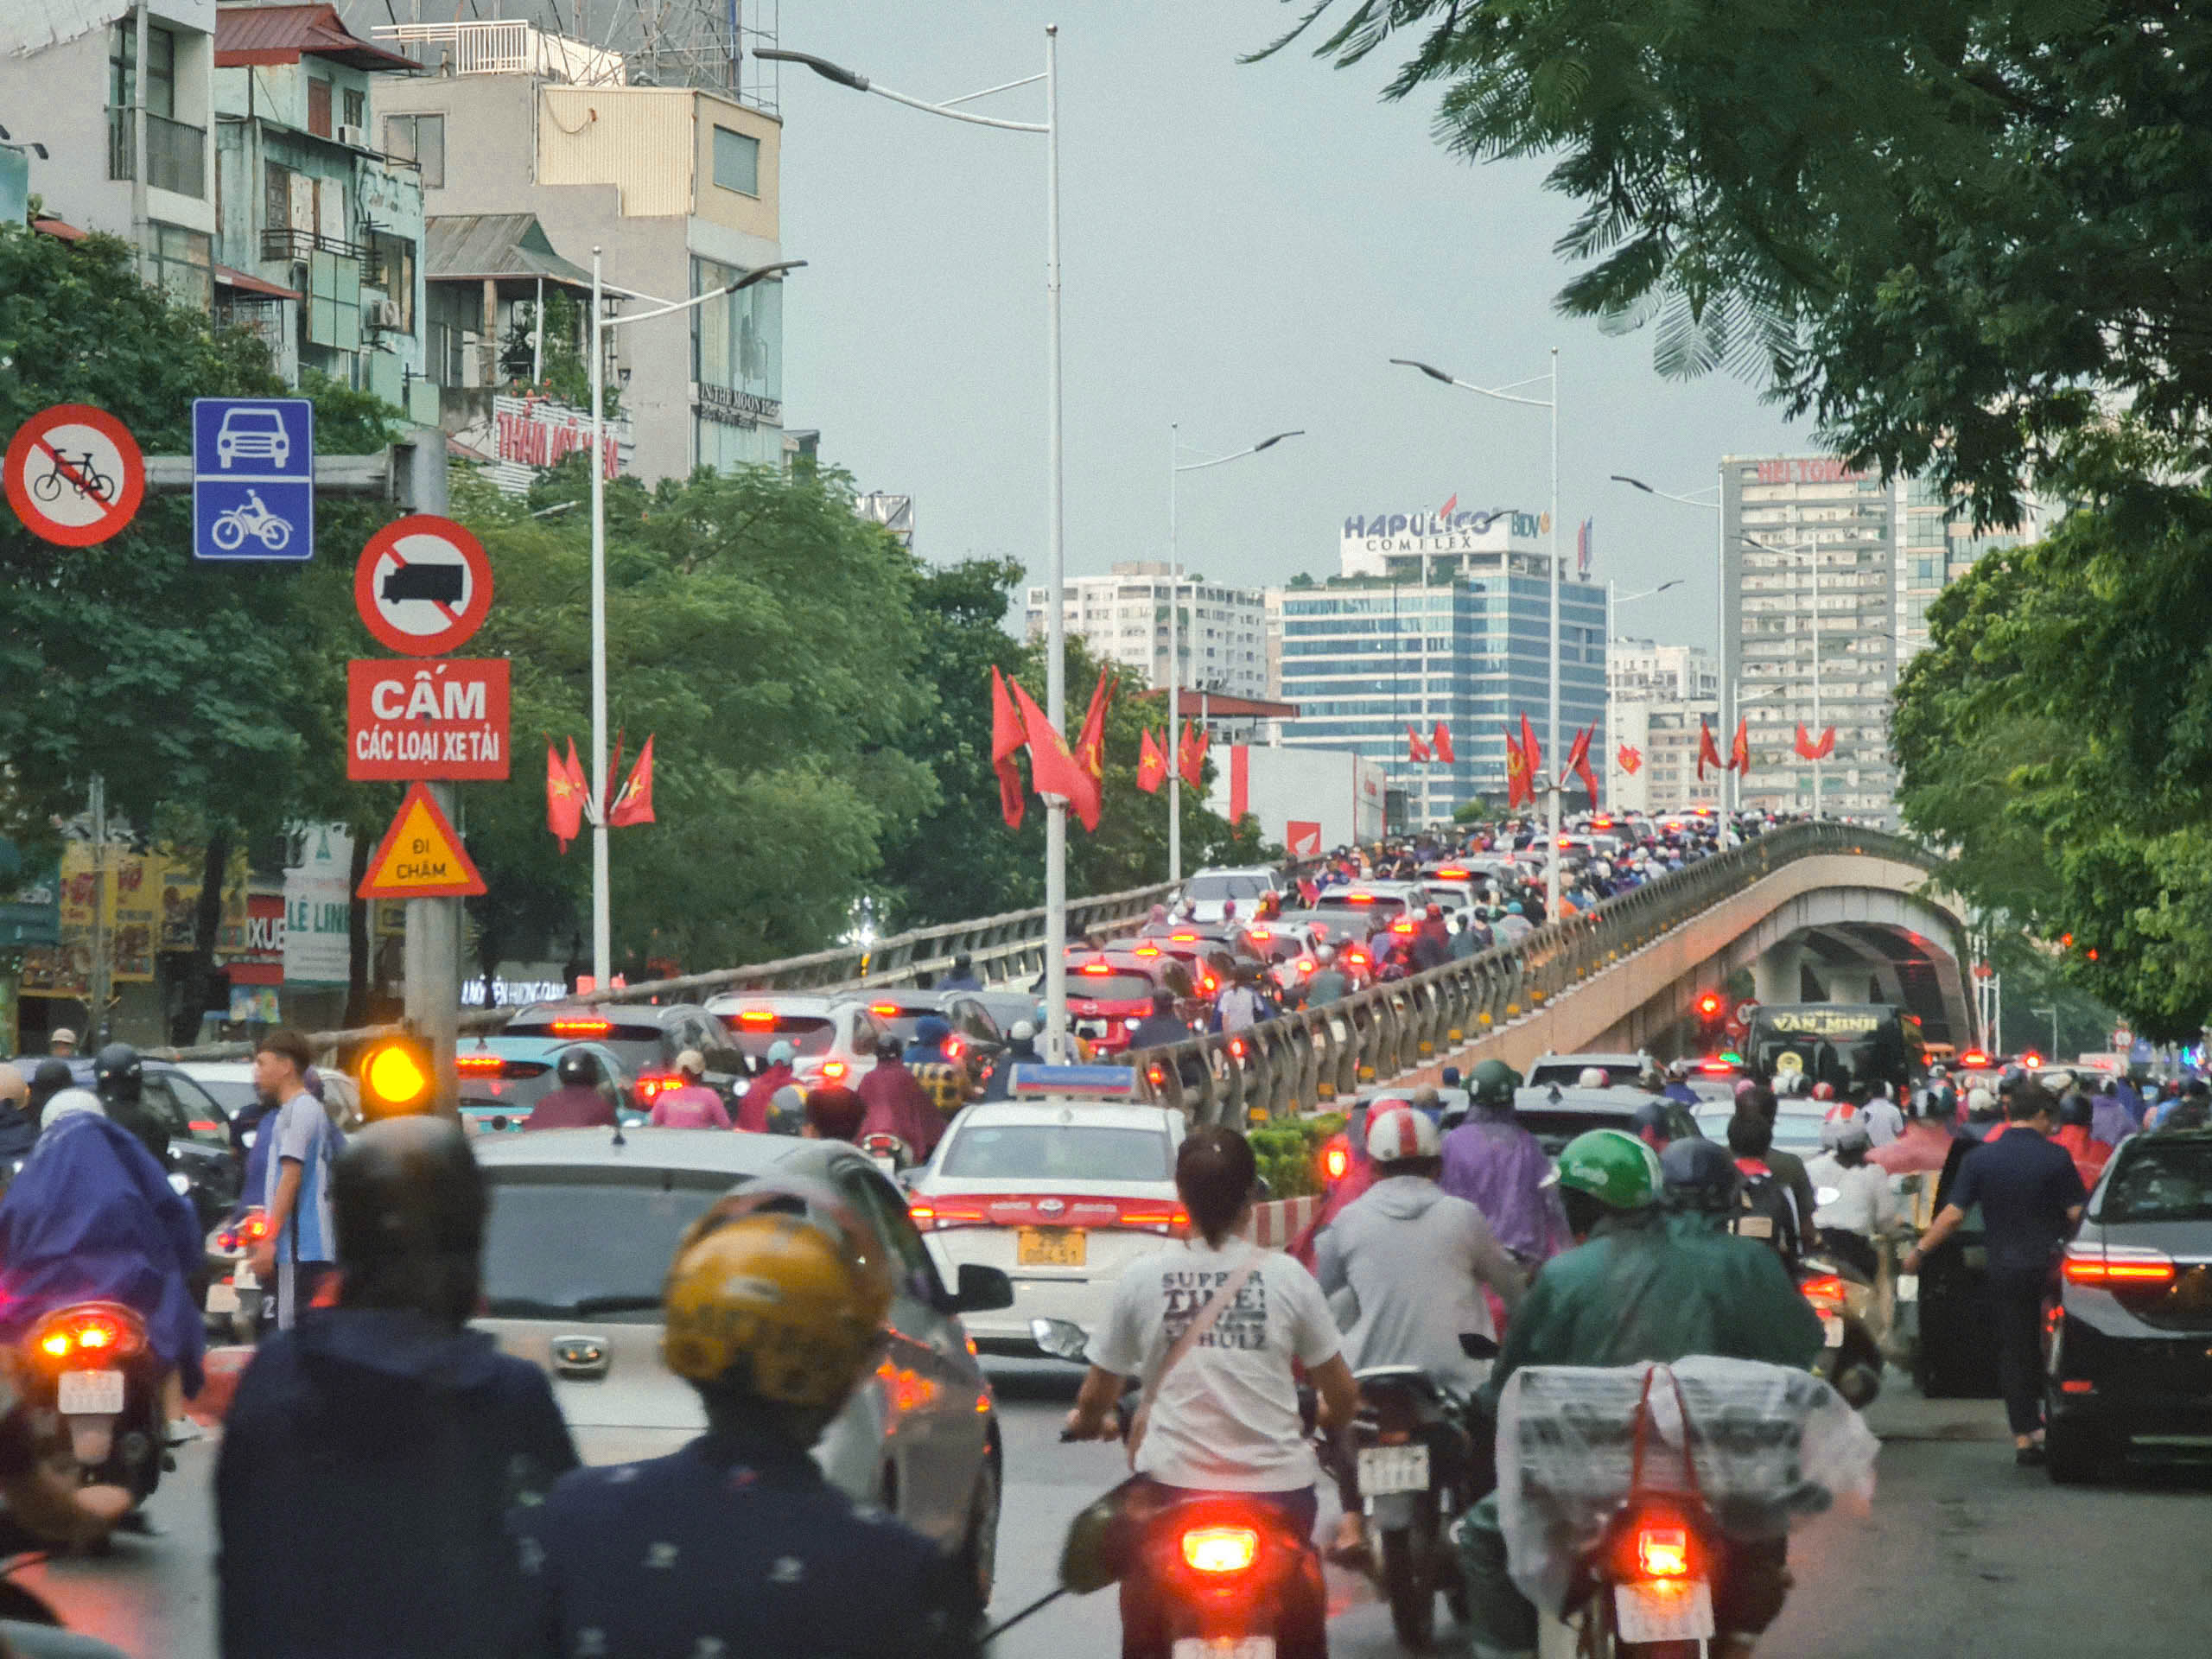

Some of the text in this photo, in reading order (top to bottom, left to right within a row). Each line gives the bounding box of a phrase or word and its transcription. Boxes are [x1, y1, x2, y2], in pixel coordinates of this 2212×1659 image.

[733, 391, 760, 411] MOON
[1344, 510, 1492, 539] HAPULICO
[371, 664, 486, 721] CẤM
[356, 722, 500, 766] CÁC LOẠI XE TẢI
[412, 838, 429, 855] ĐI
[1162, 1270, 1265, 1287] SUPPR
